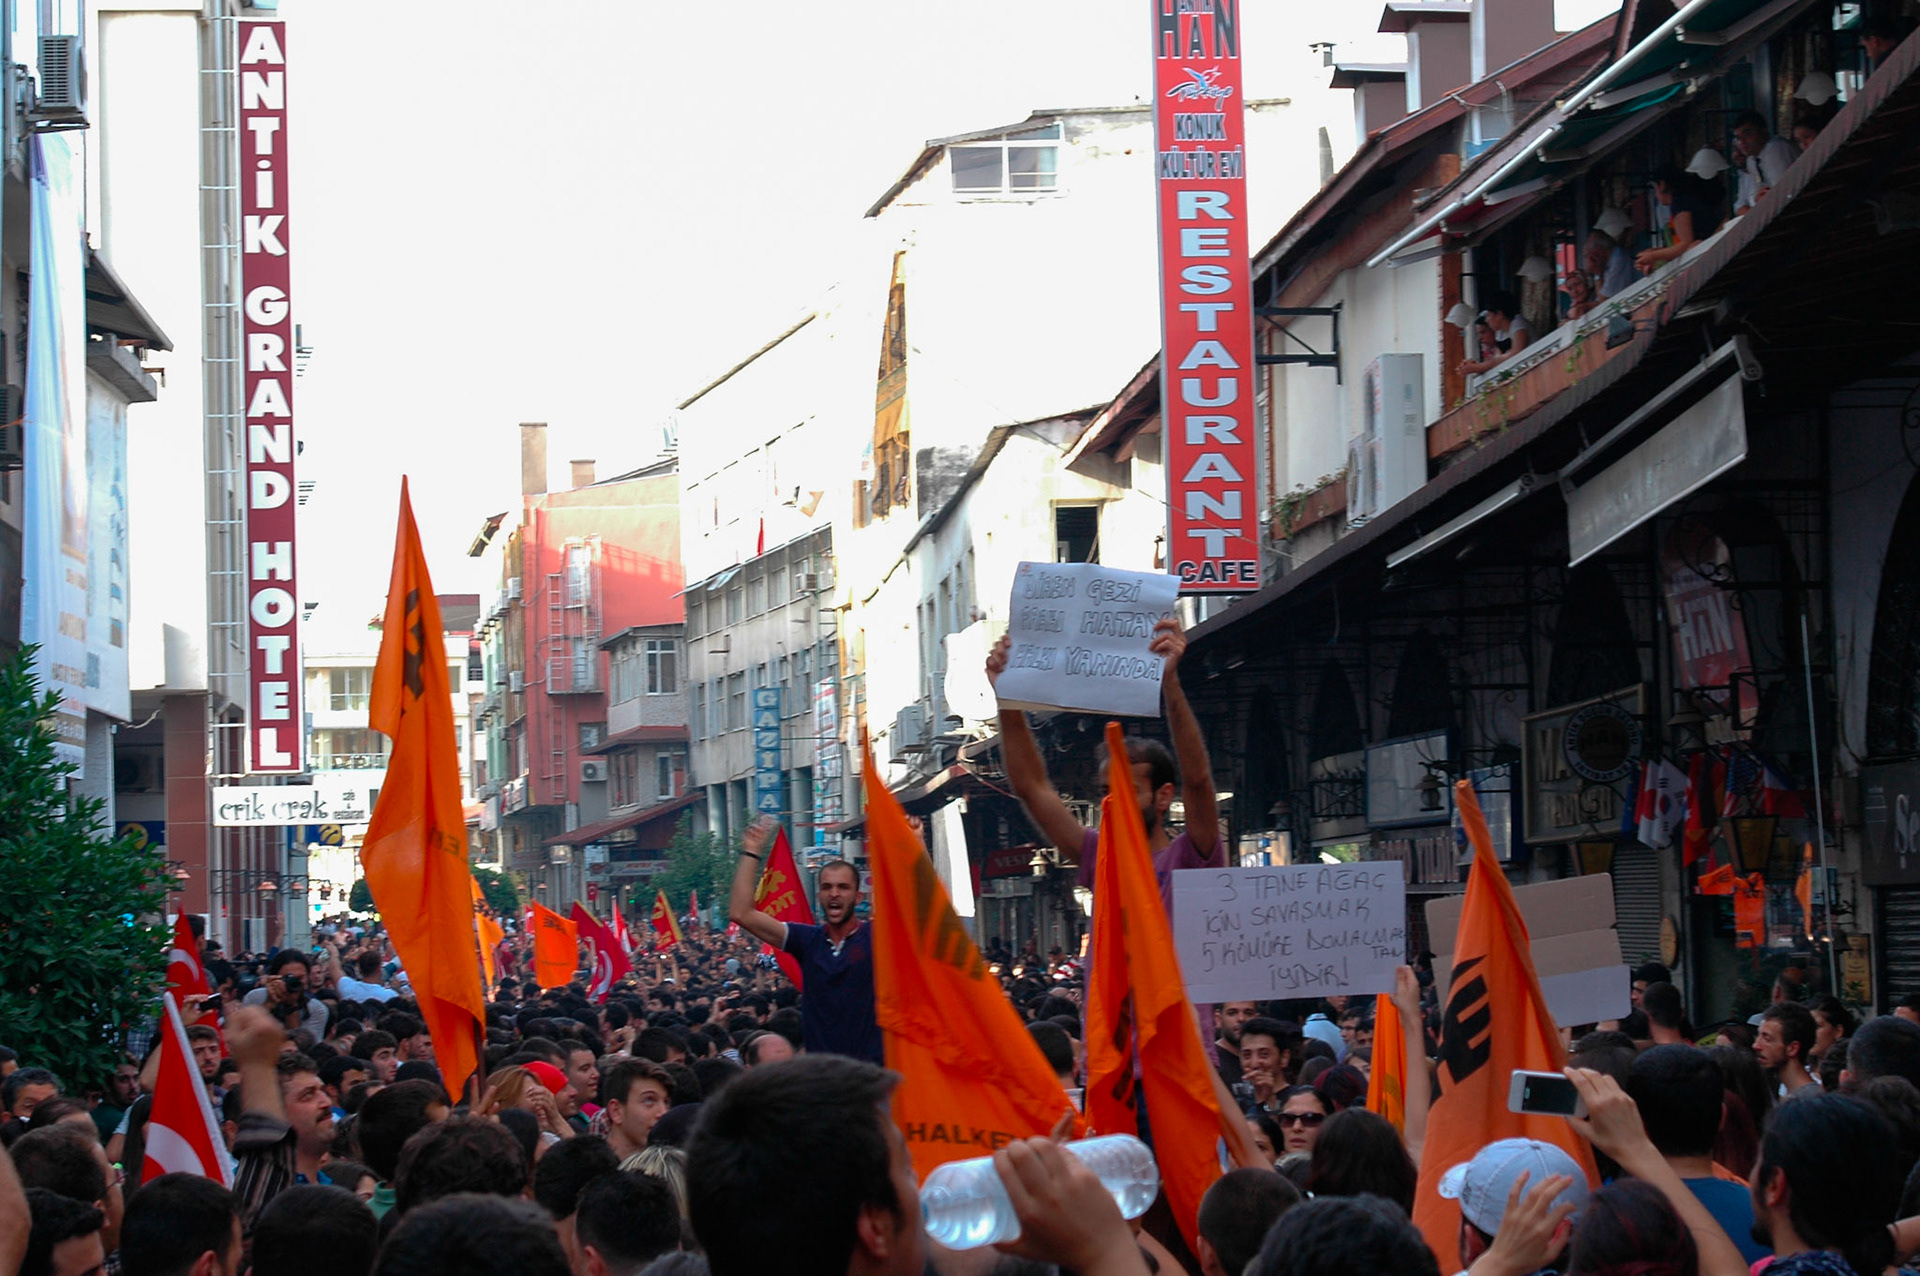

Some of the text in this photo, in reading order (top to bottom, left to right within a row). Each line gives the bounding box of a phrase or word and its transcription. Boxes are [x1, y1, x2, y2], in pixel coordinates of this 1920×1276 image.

[1156, 0, 1239, 60] HAN
[1173, 112, 1228, 142] KONUK
[1160, 145, 1217, 180] KÜLTÜR
[1176, 190, 1245, 558] RESTAURANT
[245, 286, 291, 510] GRAND
[1176, 560, 1257, 583] CAFE
[1086, 578, 1143, 606] GEZİ
[1080, 610, 1171, 639] HATAY
[1674, 591, 1734, 661] HAN
[250, 542, 296, 768] HOTEL
[1217, 873, 1239, 902] 3
[1245, 872, 1308, 899] TANE
[1202, 941, 1217, 972] 5
